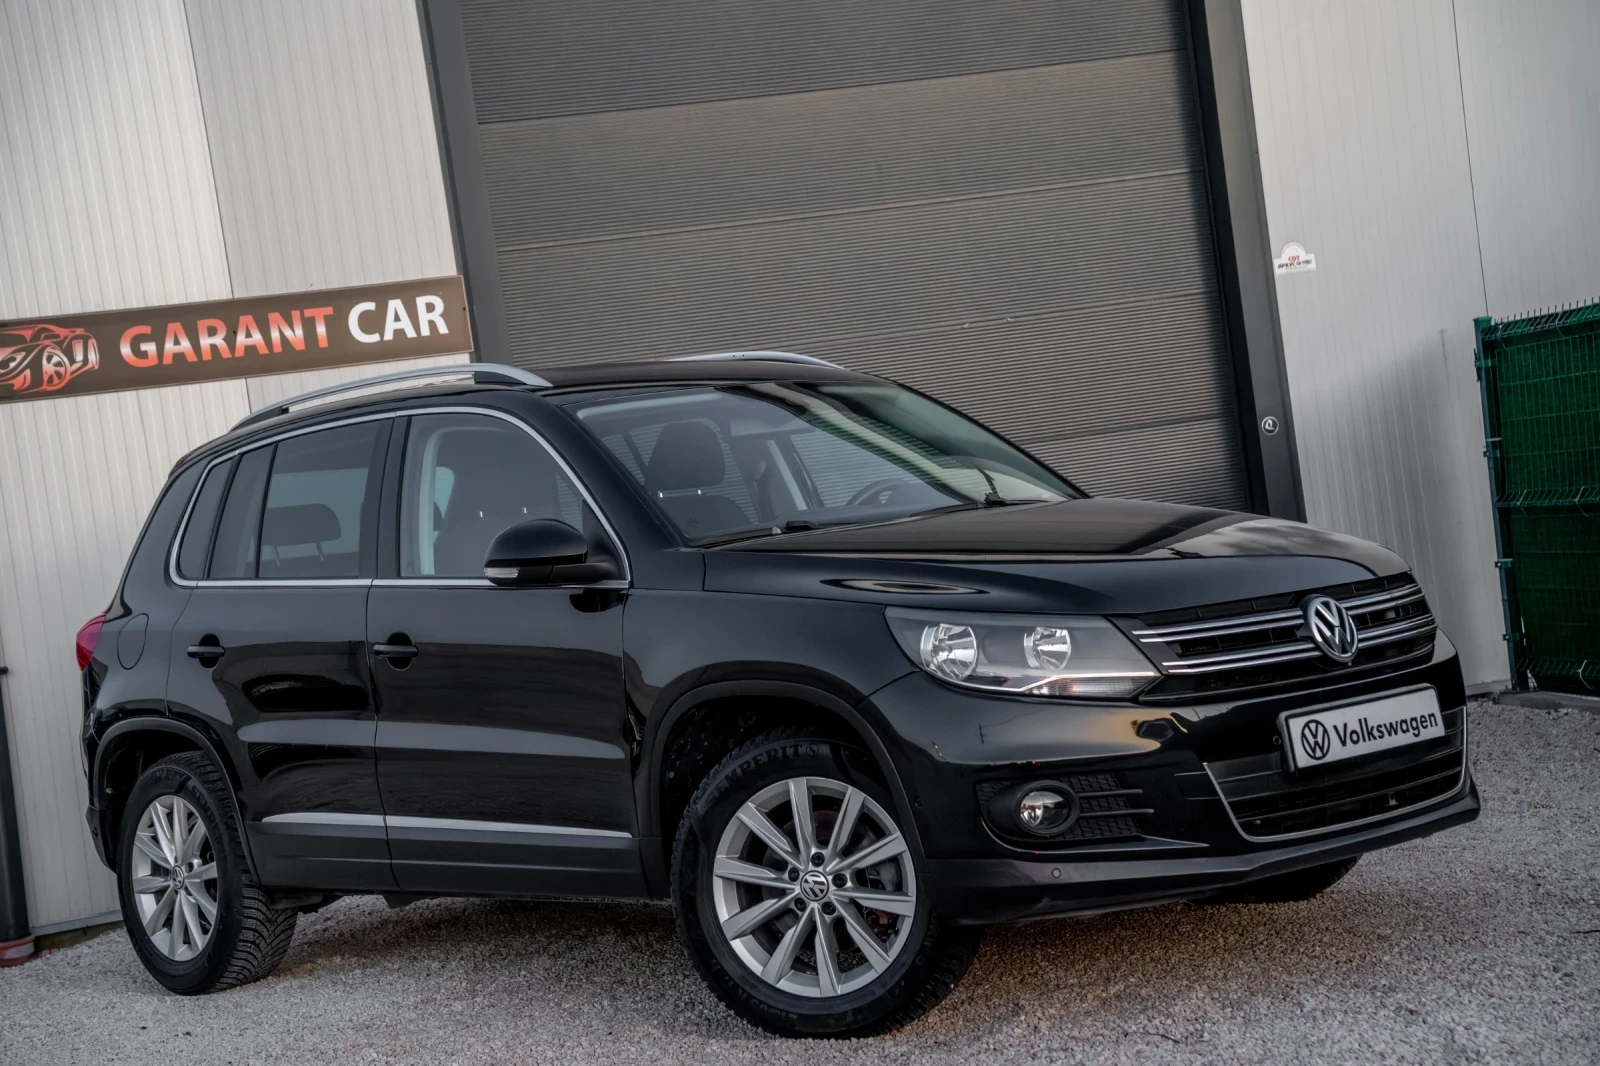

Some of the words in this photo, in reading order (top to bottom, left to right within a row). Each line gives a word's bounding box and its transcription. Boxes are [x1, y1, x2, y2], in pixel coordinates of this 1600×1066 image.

[119, 306, 334, 368] GARANT
[347, 295, 450, 343] CAR
[1333, 712, 1439, 748] Volkswagen
